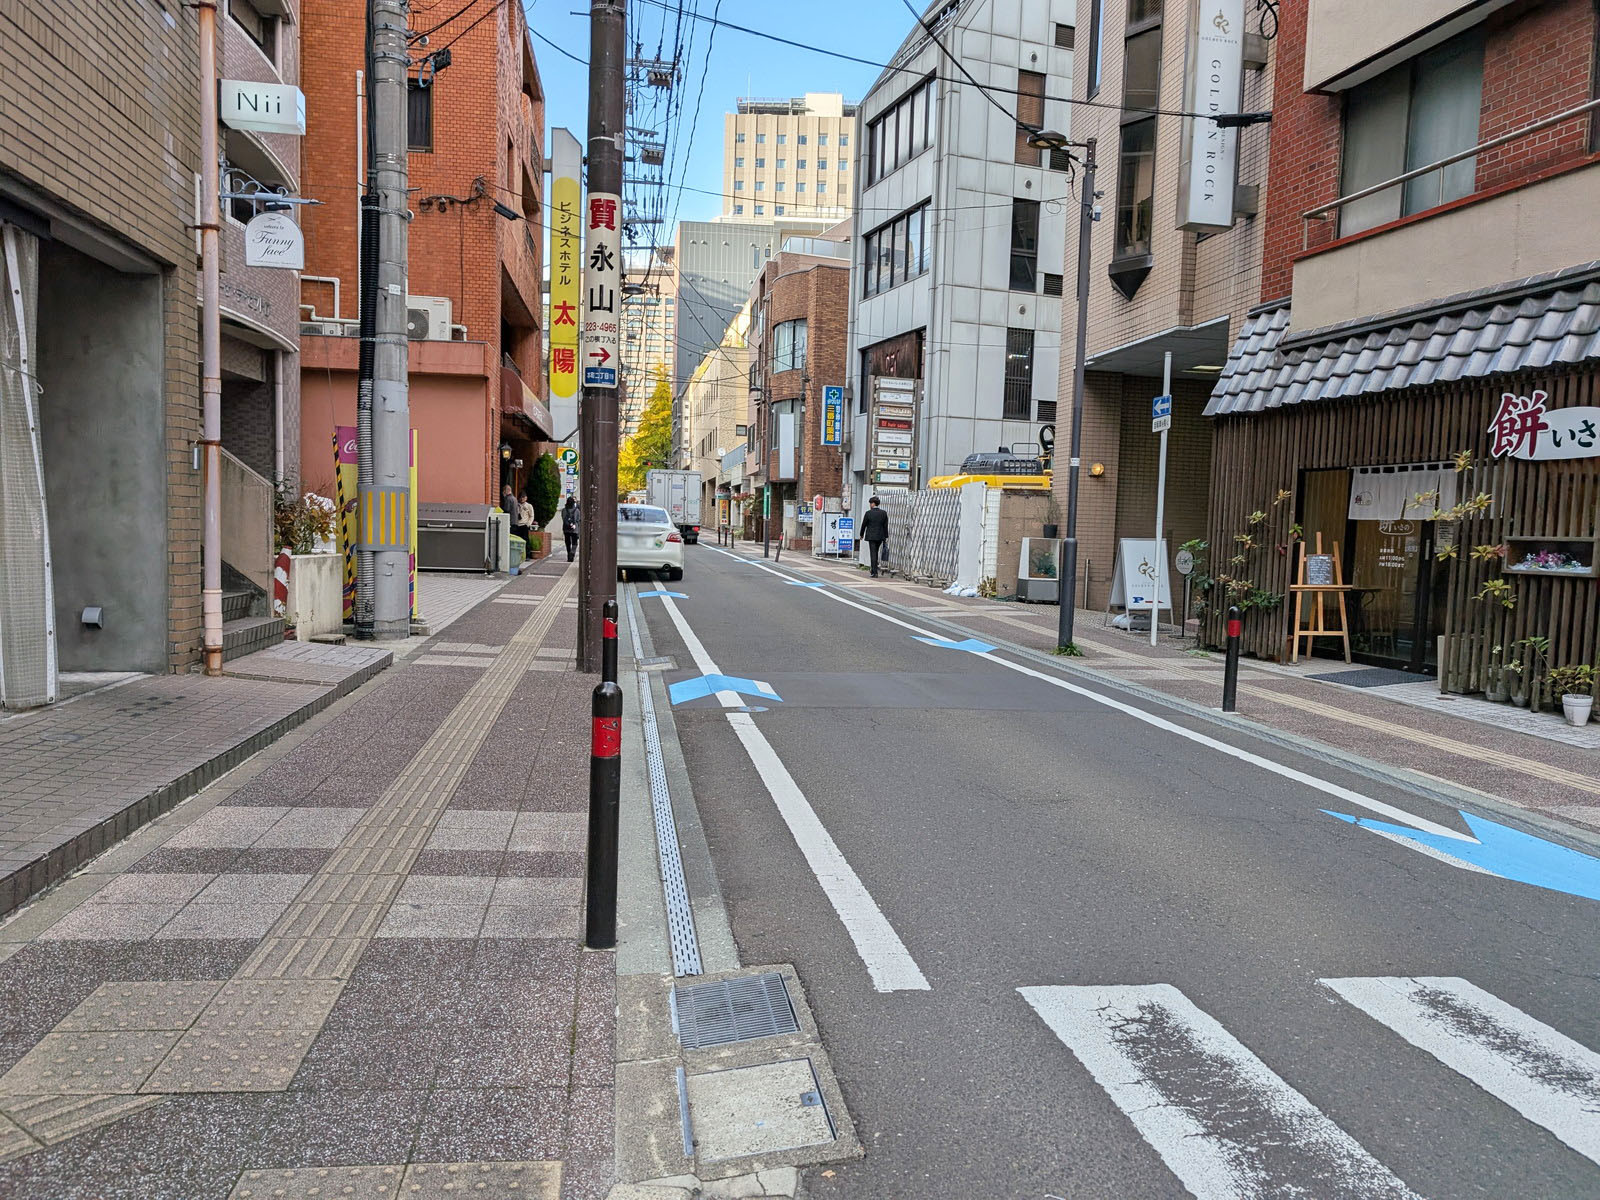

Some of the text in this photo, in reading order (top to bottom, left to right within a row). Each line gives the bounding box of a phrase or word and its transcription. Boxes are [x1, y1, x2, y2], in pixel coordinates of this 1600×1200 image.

[237, 92, 280, 114] Nii
[1204, 151, 1216, 202] ROCK
[252, 230, 294, 251] Funny
[257, 244, 286, 259] face
[589, 198, 617, 313] 質 永山
[553, 201, 576, 374] ビジネスホテル 太陽
[585, 322, 616, 333] 223-4965
[1489, 391, 1597, 458] 餅 いさ
